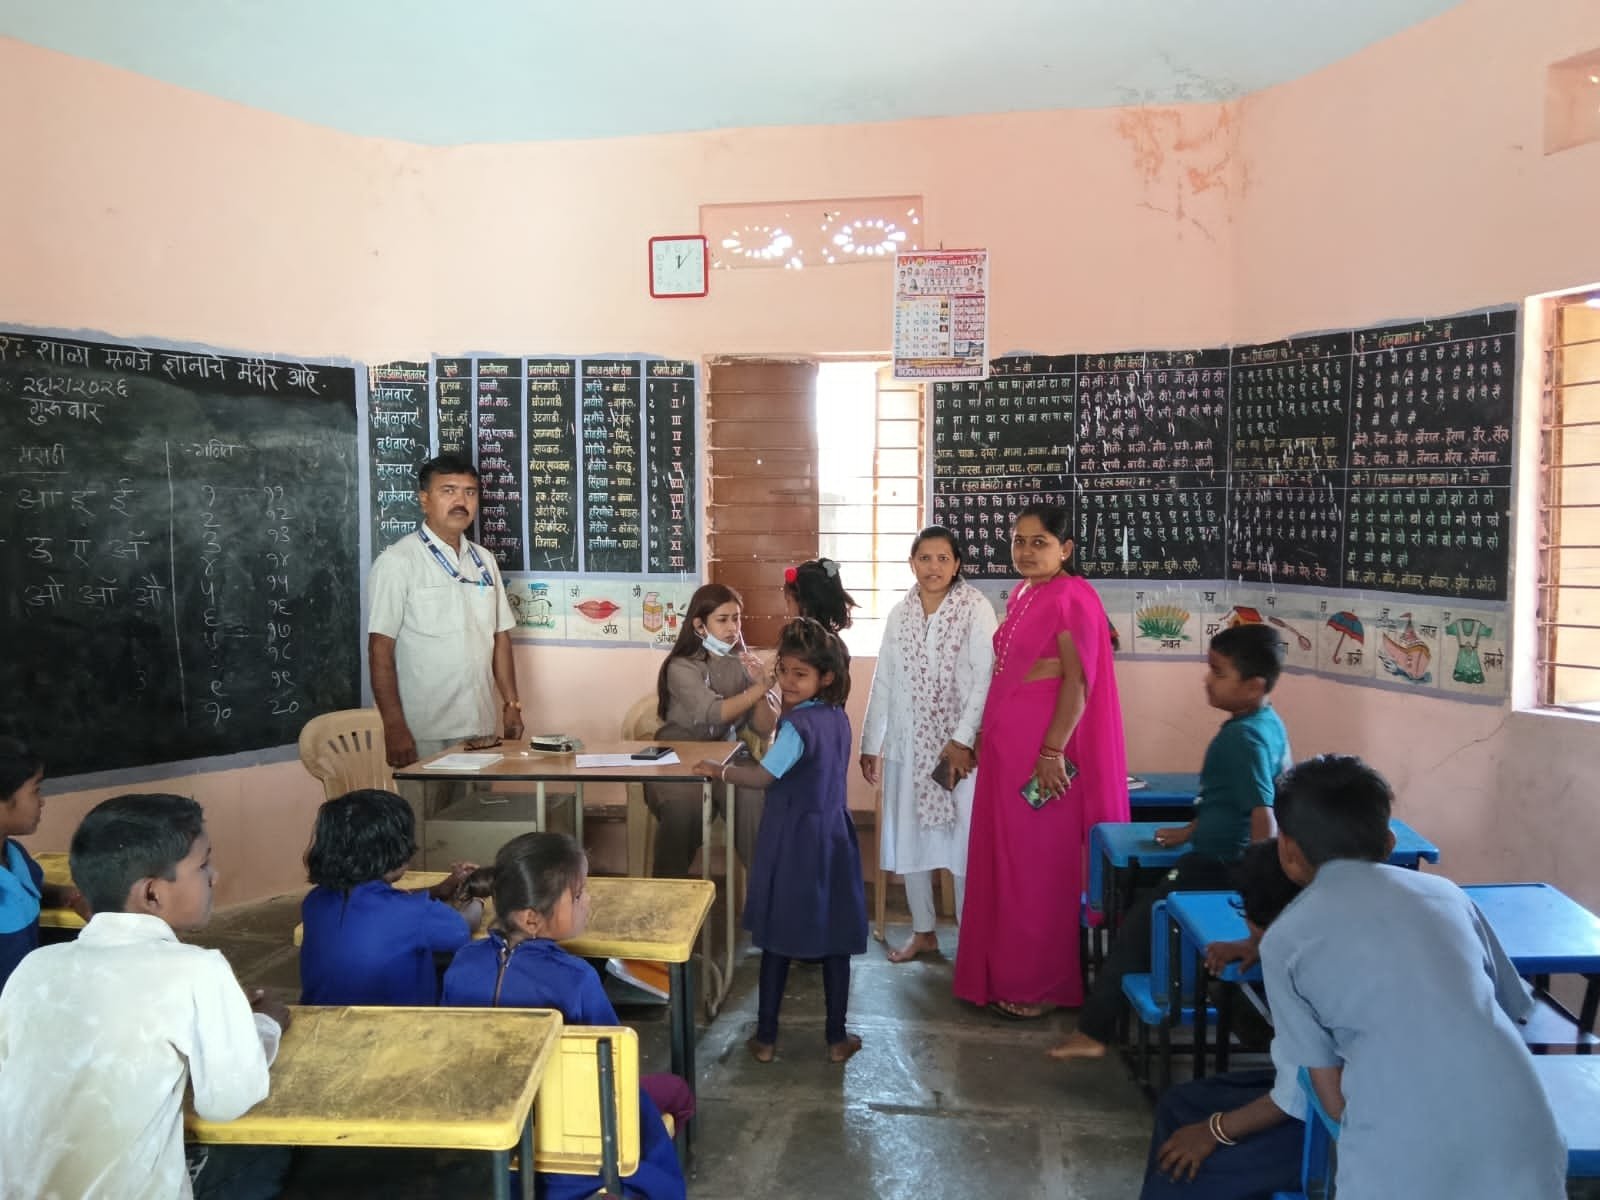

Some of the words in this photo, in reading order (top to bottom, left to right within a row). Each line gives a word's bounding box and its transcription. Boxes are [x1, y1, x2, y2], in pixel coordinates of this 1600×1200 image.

[32, 340, 90, 368] शाळा
[160, 351, 231, 380] ज्ञानाचे
[672, 382, 679, 393] I
[671, 398, 680, 408] II
[671, 415, 682, 425] III
[16, 488, 64, 509] आ
[200, 511, 222, 528] २
[672, 509, 682, 519] IX
[672, 525, 683, 535] X
[26, 537, 53, 563] उ
